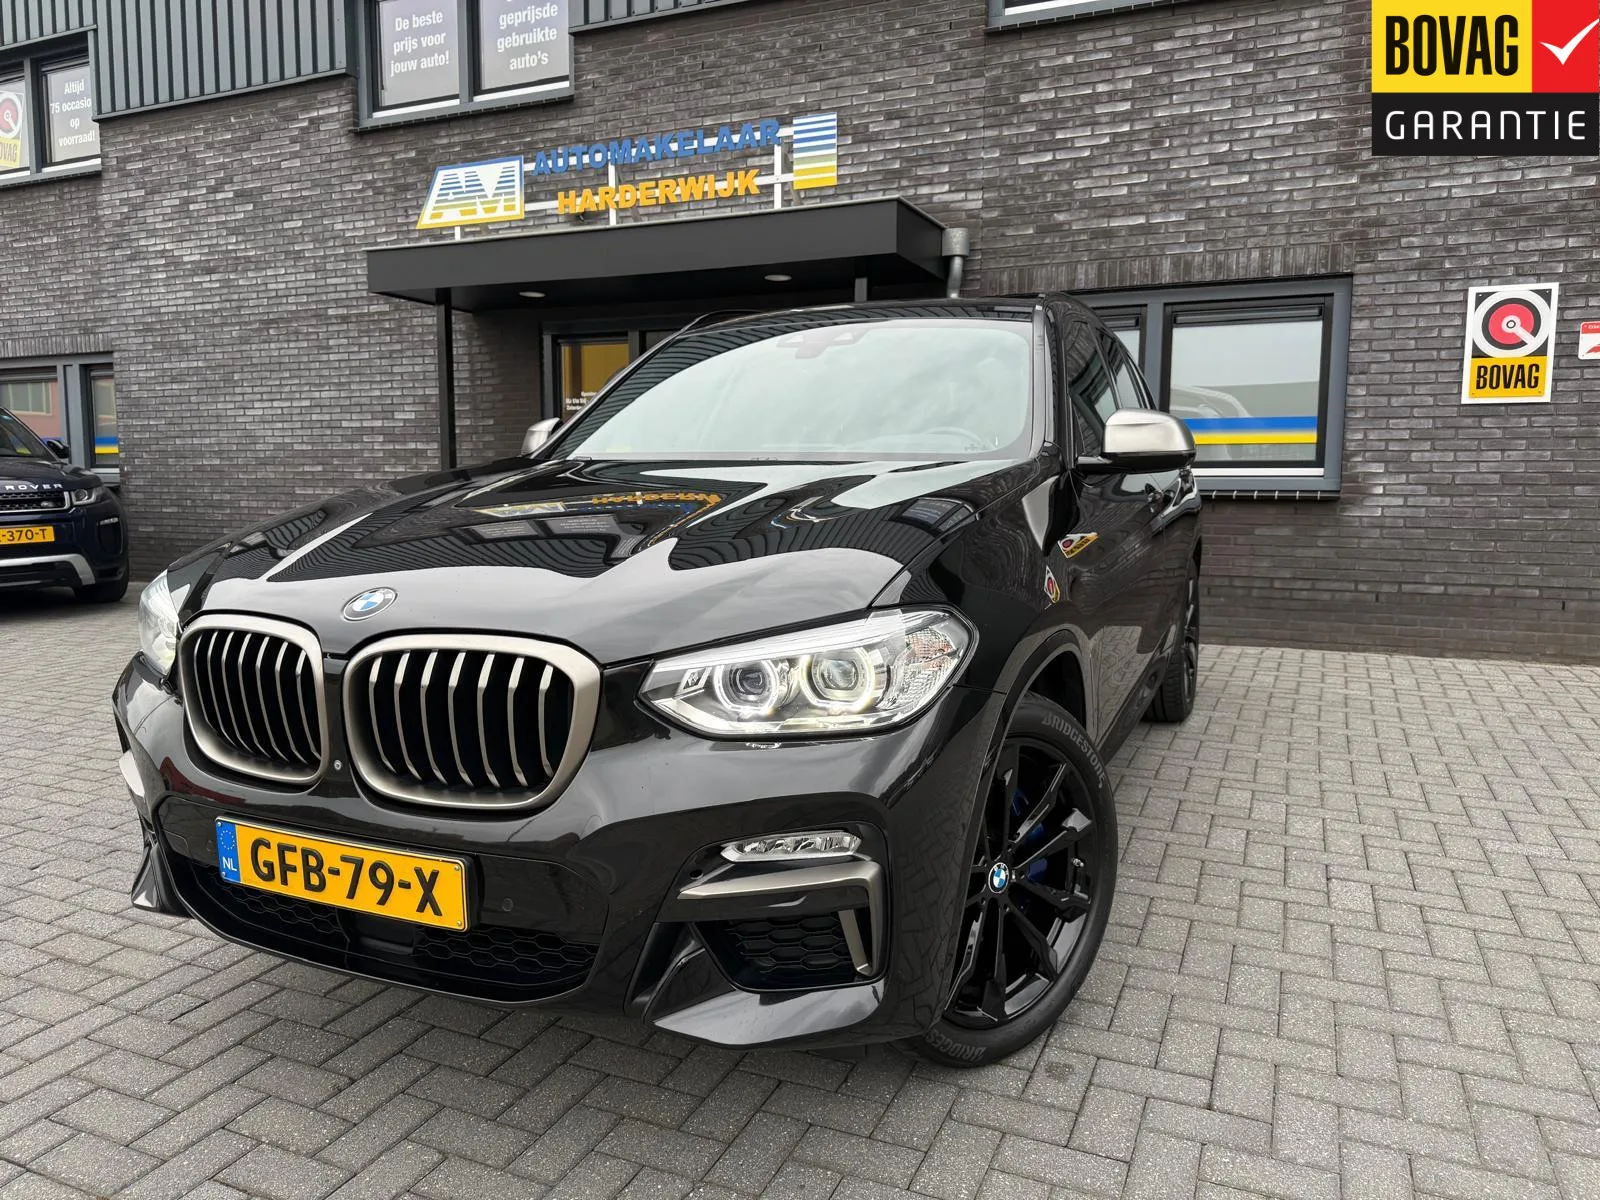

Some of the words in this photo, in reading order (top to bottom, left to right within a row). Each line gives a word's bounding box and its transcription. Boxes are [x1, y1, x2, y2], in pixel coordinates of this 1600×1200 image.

[395, 17, 409, 31] De
[413, 10, 443, 27] beste
[499, 3, 558, 30] geprijsde
[393, 37, 418, 55] prijs
[421, 31, 446, 48] voor
[497, 27, 558, 52] gebruikte
[390, 58, 418, 77] jouw
[420, 50, 449, 69] auto!
[509, 51, 549, 70] auto's
[64, 79, 85, 95] Altijd
[50, 103, 60, 114] 75
[70, 117, 80, 130] op
[58, 130, 95, 147] voorraad!
[532, 117, 780, 176] AUTOMAKELAAR
[557, 168, 760, 214] HARDERWIJK
[1475, 363, 1540, 390] BOVAG
[5, 483, 63, 491] ROVER
[222, 856, 237, 872] NL
[250, 837, 442, 917] GFB-79-X
